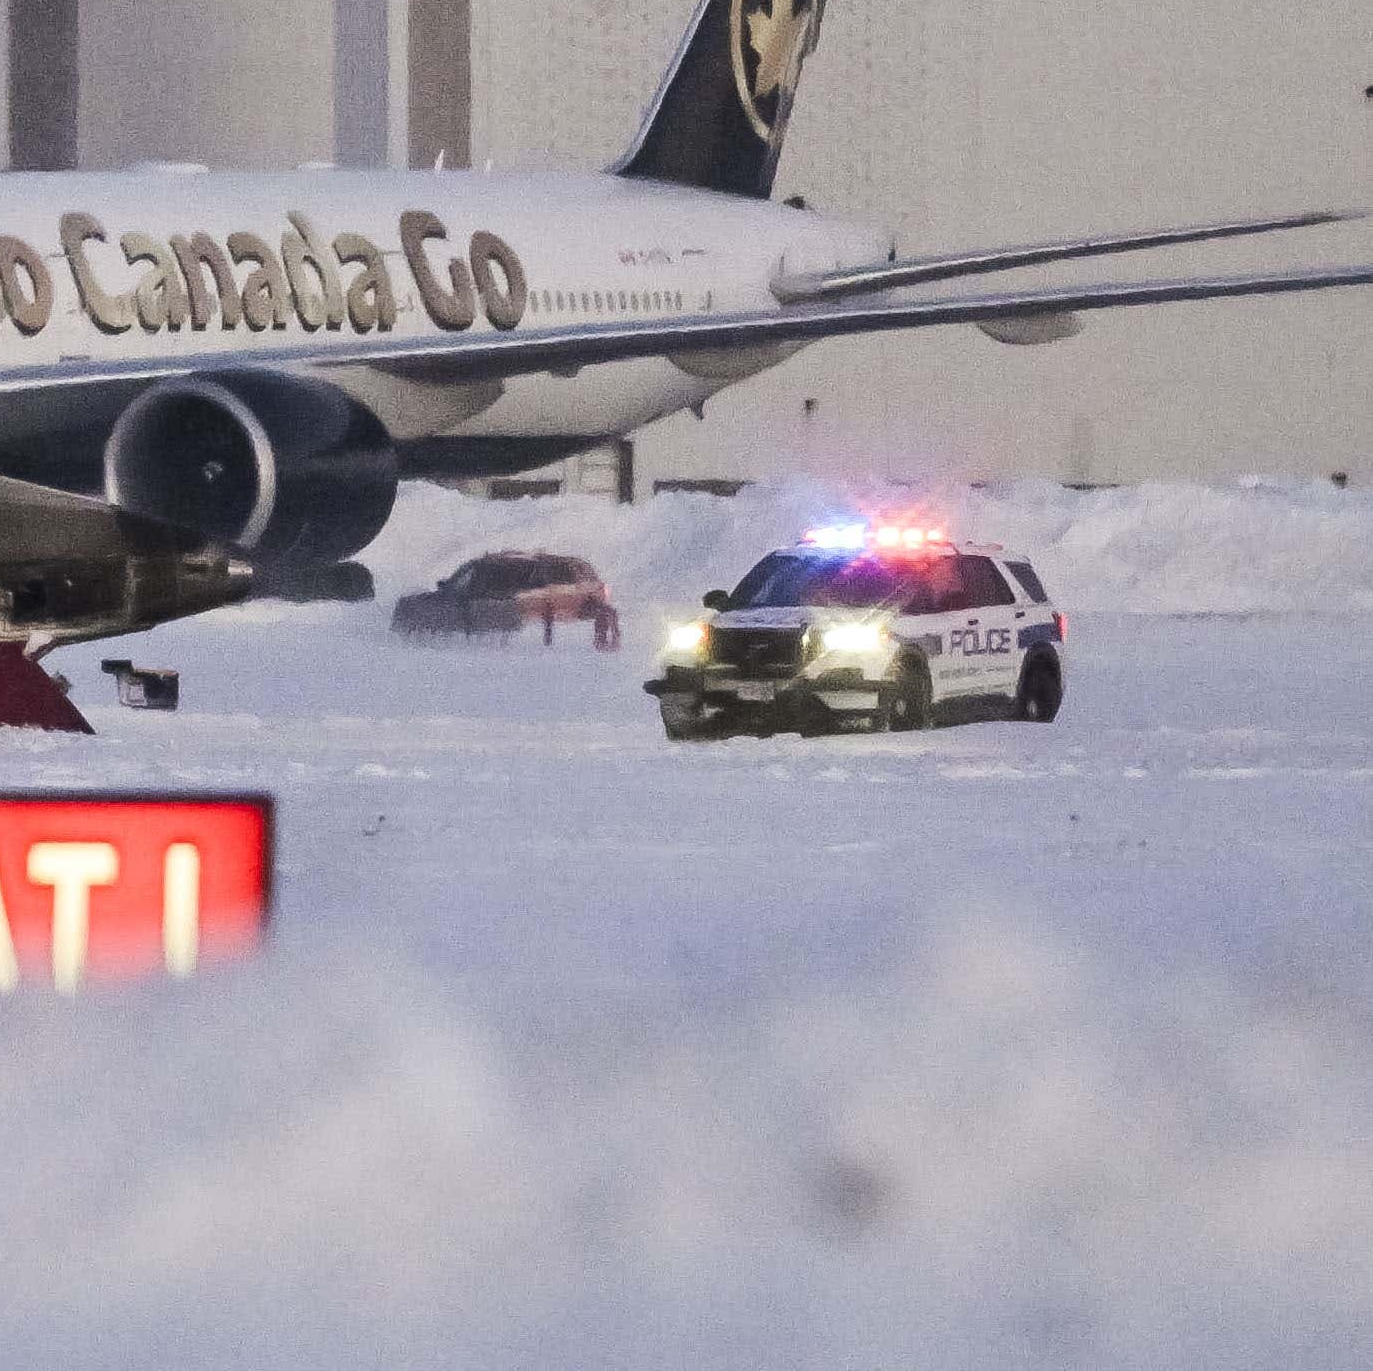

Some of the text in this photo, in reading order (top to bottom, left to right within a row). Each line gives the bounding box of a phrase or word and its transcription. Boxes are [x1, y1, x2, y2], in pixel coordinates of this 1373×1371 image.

[59, 210, 397, 335] Canada
[399, 210, 527, 332] Go
[950, 628, 1012, 657] POLICE
